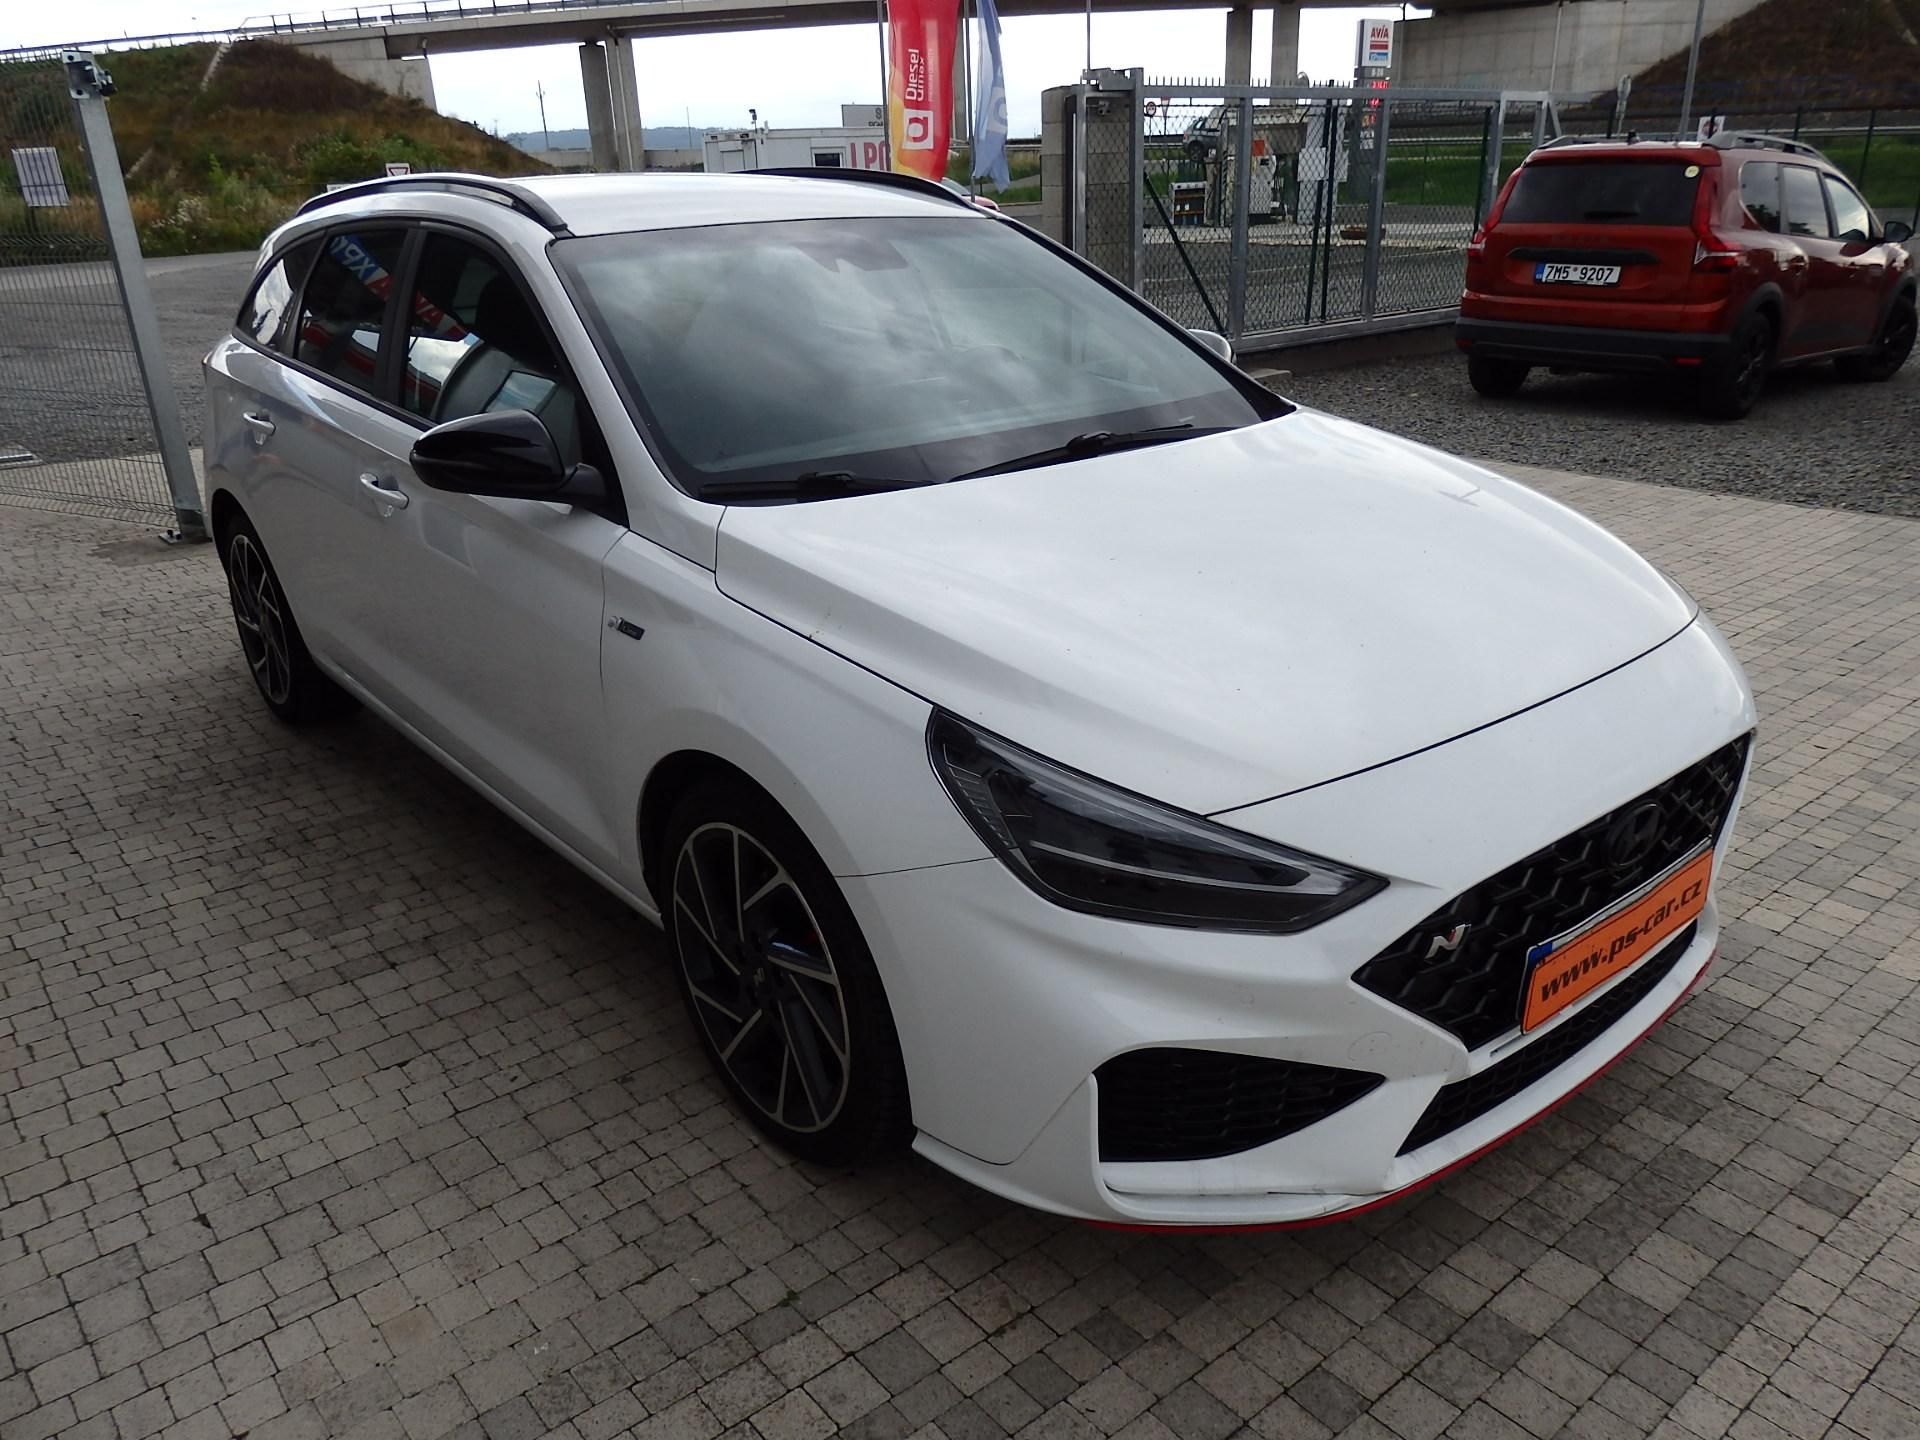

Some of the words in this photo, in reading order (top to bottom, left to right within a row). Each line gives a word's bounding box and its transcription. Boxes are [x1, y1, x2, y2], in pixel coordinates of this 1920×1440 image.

[905, 49, 919, 100] Diesel
[1546, 265, 1571, 280] 7M5
[1579, 267, 1614, 281] 9207
[1540, 879, 1704, 1003] www.ps-car.cz
